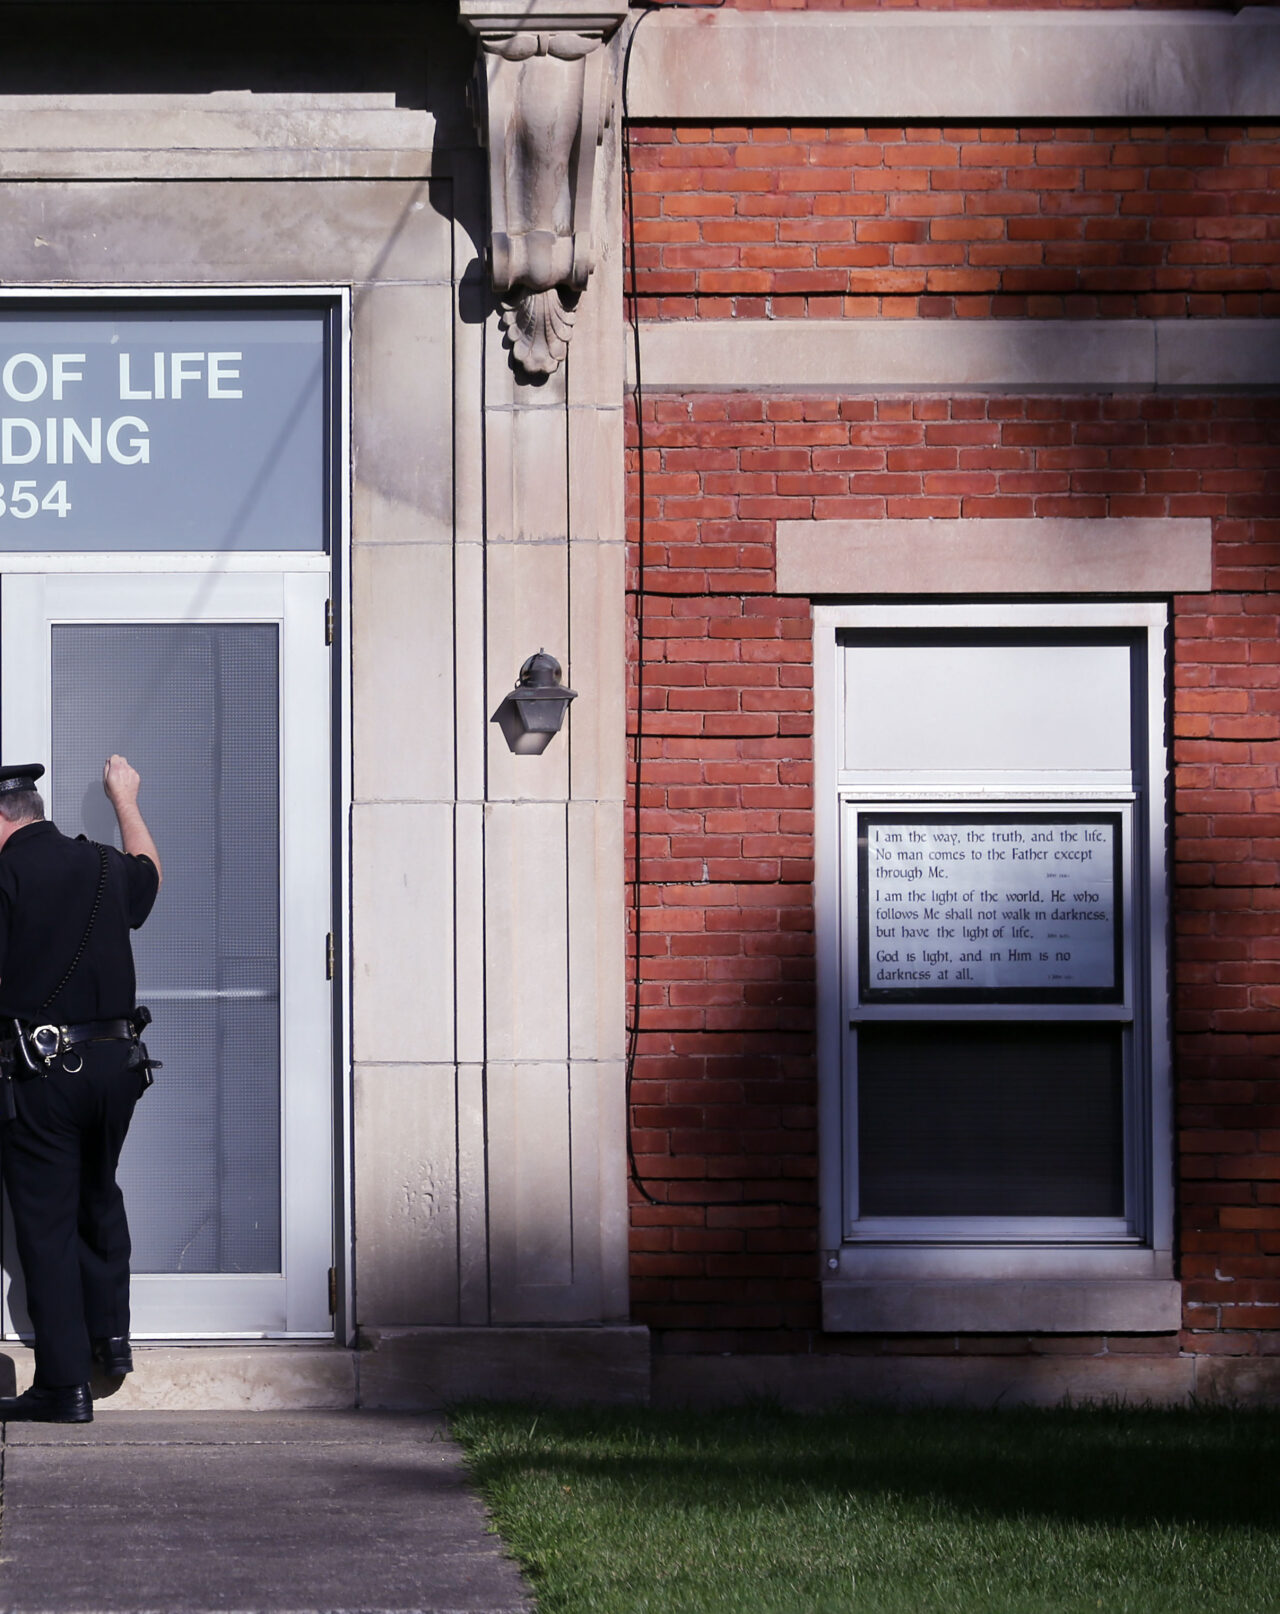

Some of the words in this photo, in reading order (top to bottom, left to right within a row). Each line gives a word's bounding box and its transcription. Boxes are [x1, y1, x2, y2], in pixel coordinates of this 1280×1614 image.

[3, 353, 85, 402] OF
[120, 352, 242, 399] LIFE
[876, 830, 880, 843] I
[883, 834, 904, 843] am
[908, 831, 927, 843] the
[966, 831, 986, 843] the
[1030, 830, 1054, 842] and
[1059, 830, 1079, 842] the
[875, 848, 892, 860] No
[896, 851, 924, 860] man
[928, 851, 966, 860] comes
[970, 850, 983, 860] to
[986, 848, 1006, 860] the
[1011, 848, 1049, 861] Father
[1053, 850, 1093, 862] except
[875, 866, 923, 882] through
[876, 889, 879, 902] I
[883, 893, 903, 902] am
[907, 890, 927, 902] the
[931, 890, 959, 905] light
[962, 890, 976, 902] of
[979, 890, 999, 903] the
[1050, 890, 1066, 902] He
[1072, 891, 1100, 903] who
[875, 907, 920, 920] follows
[923, 907, 941, 920] Me
[944, 908, 974, 920] shall
[977, 910, 997, 920] not
[1001, 908, 1031, 920] walk
[1034, 911, 1047, 920] in
[875, 925, 896, 937] but
[901, 926, 930, 938] have
[936, 926, 956, 938] the
[962, 926, 989, 942] light
[991, 926, 1006, 938] of
[875, 950, 900, 963] God
[905, 953, 917, 962] is
[958, 950, 984, 962] and
[989, 952, 1002, 961] in
[1007, 949, 1033, 961] Him
[1039, 952, 1049, 961] is
[1055, 952, 1071, 961] no
[876, 968, 932, 980] darkness
[936, 969, 949, 980] at
